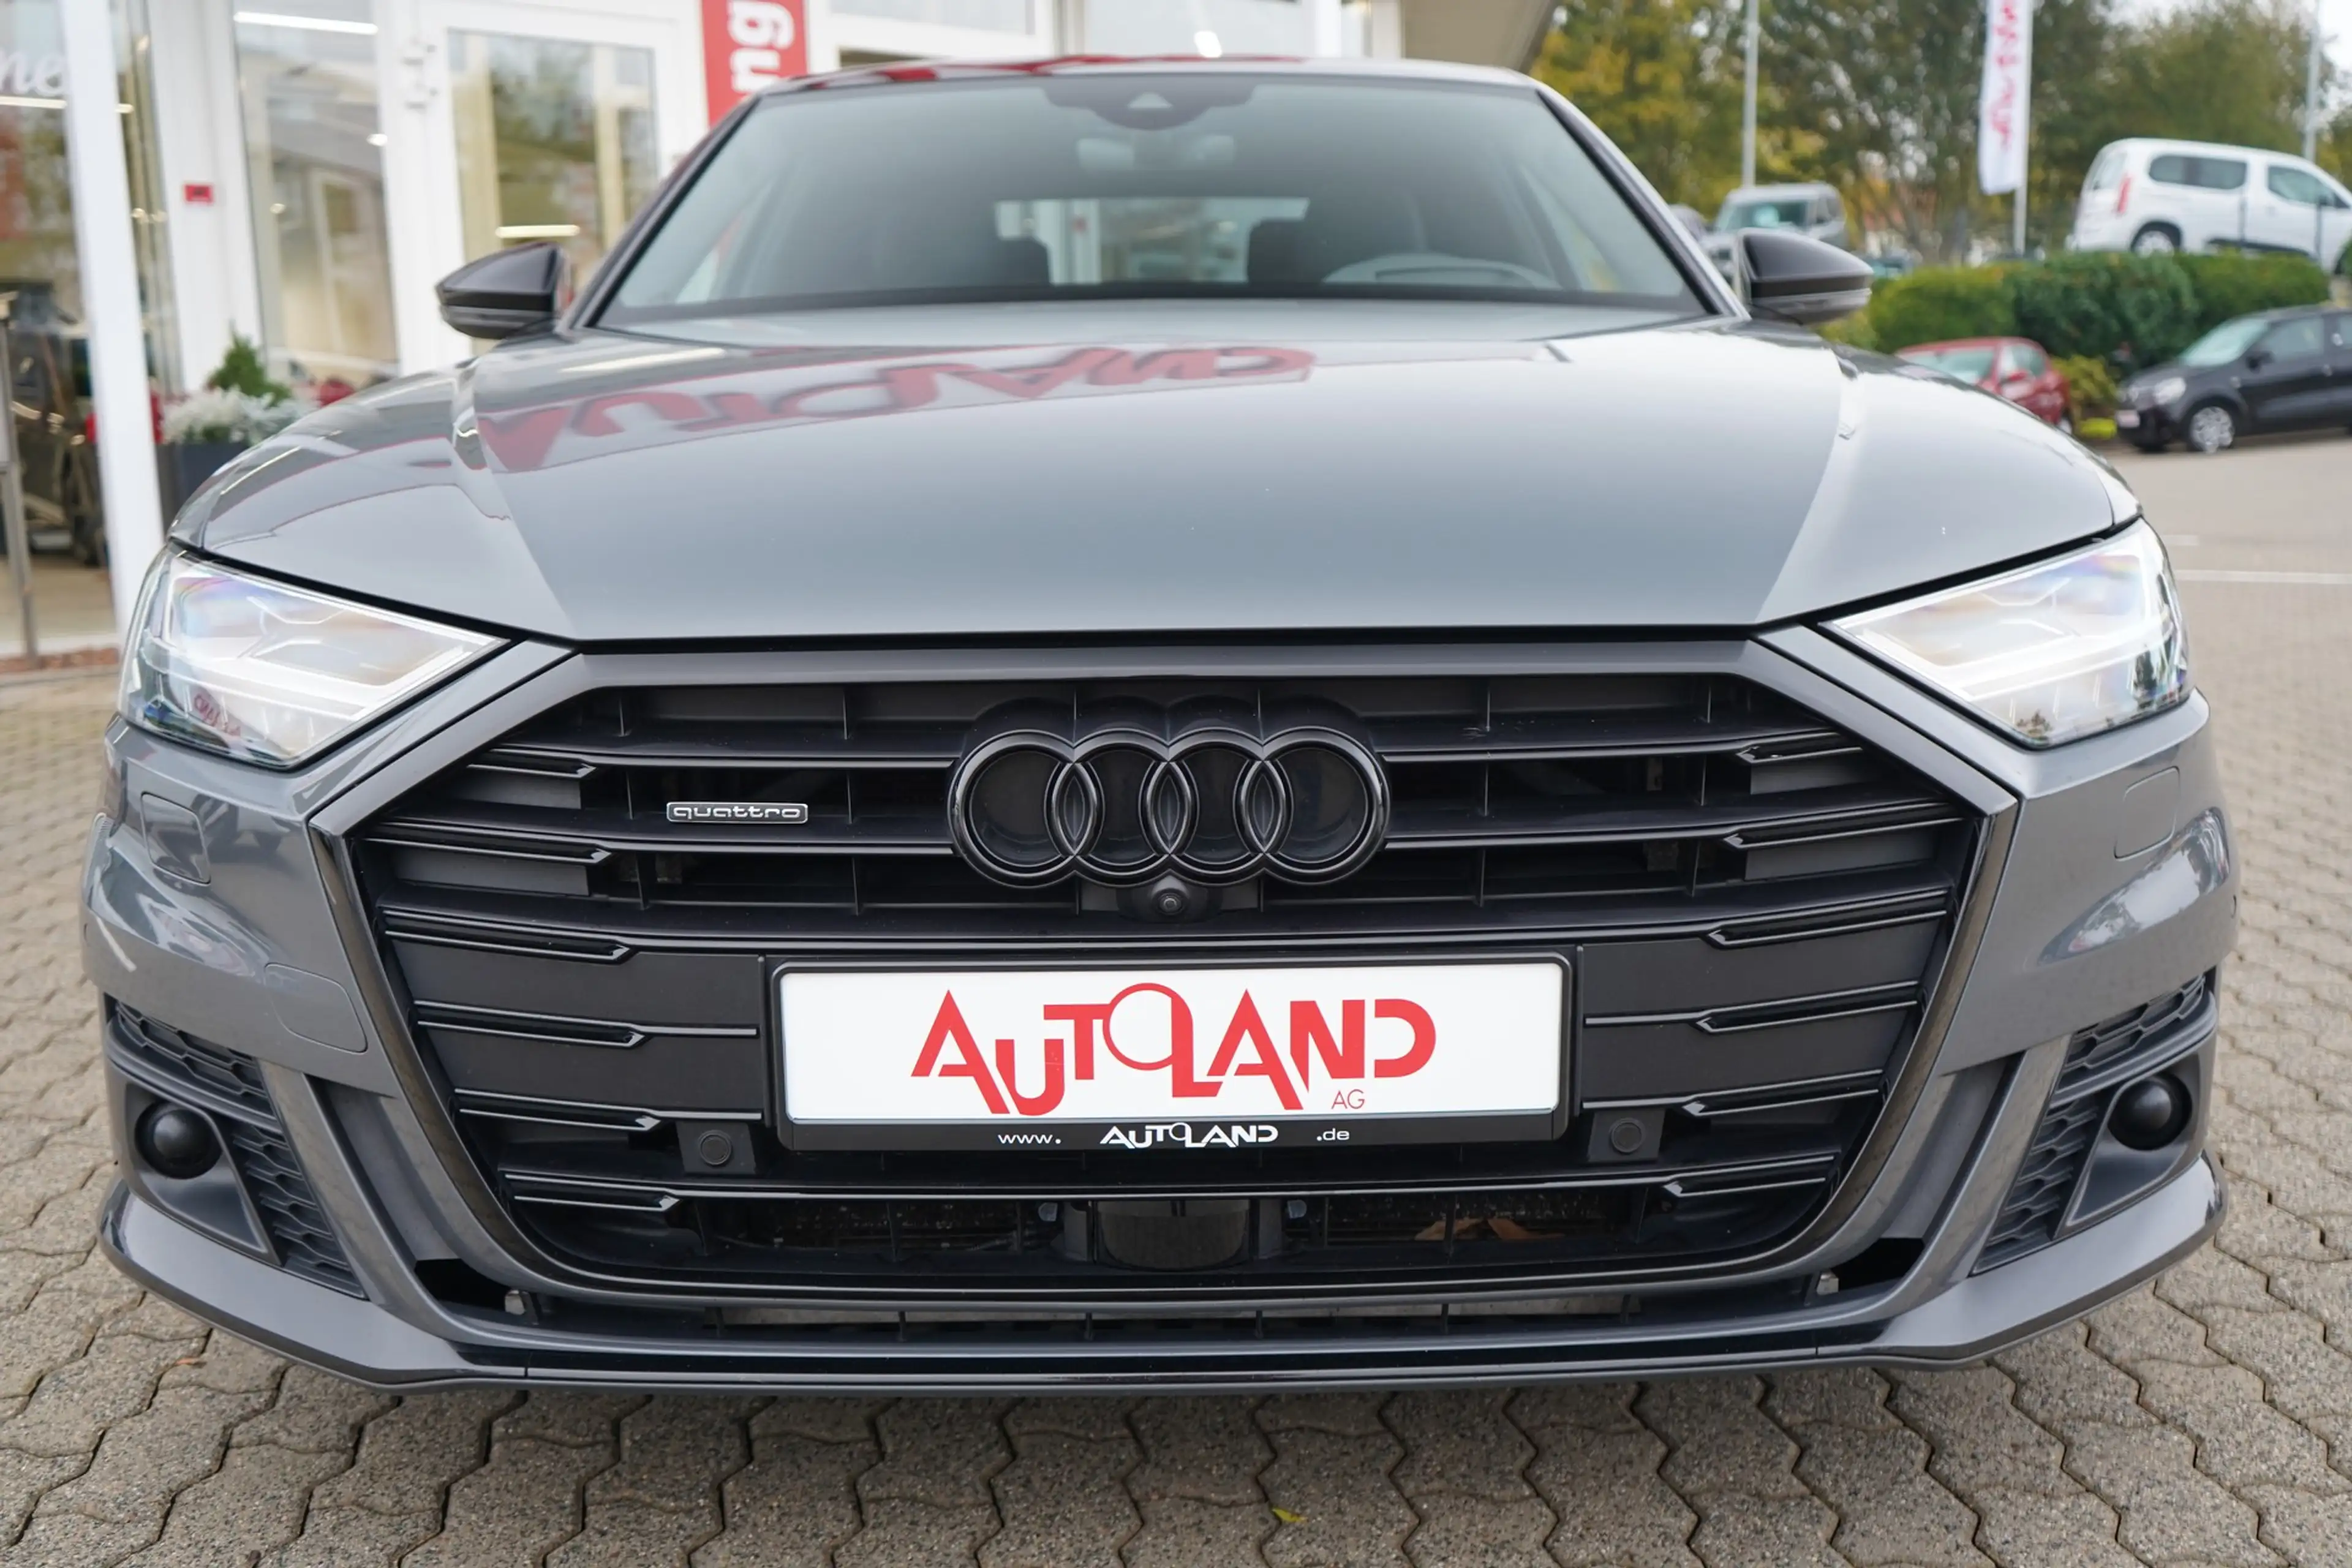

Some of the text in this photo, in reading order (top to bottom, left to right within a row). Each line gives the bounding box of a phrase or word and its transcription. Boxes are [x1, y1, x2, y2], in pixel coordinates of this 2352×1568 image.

[728, 0, 794, 99] ng
[673, 805, 801, 820] quattro
[910, 982, 1437, 1117] AUTOLAND
[1330, 1088, 1366, 1110] AG
[997, 1133, 1062, 1145] www.
[1316, 1127, 1351, 1142] .de
